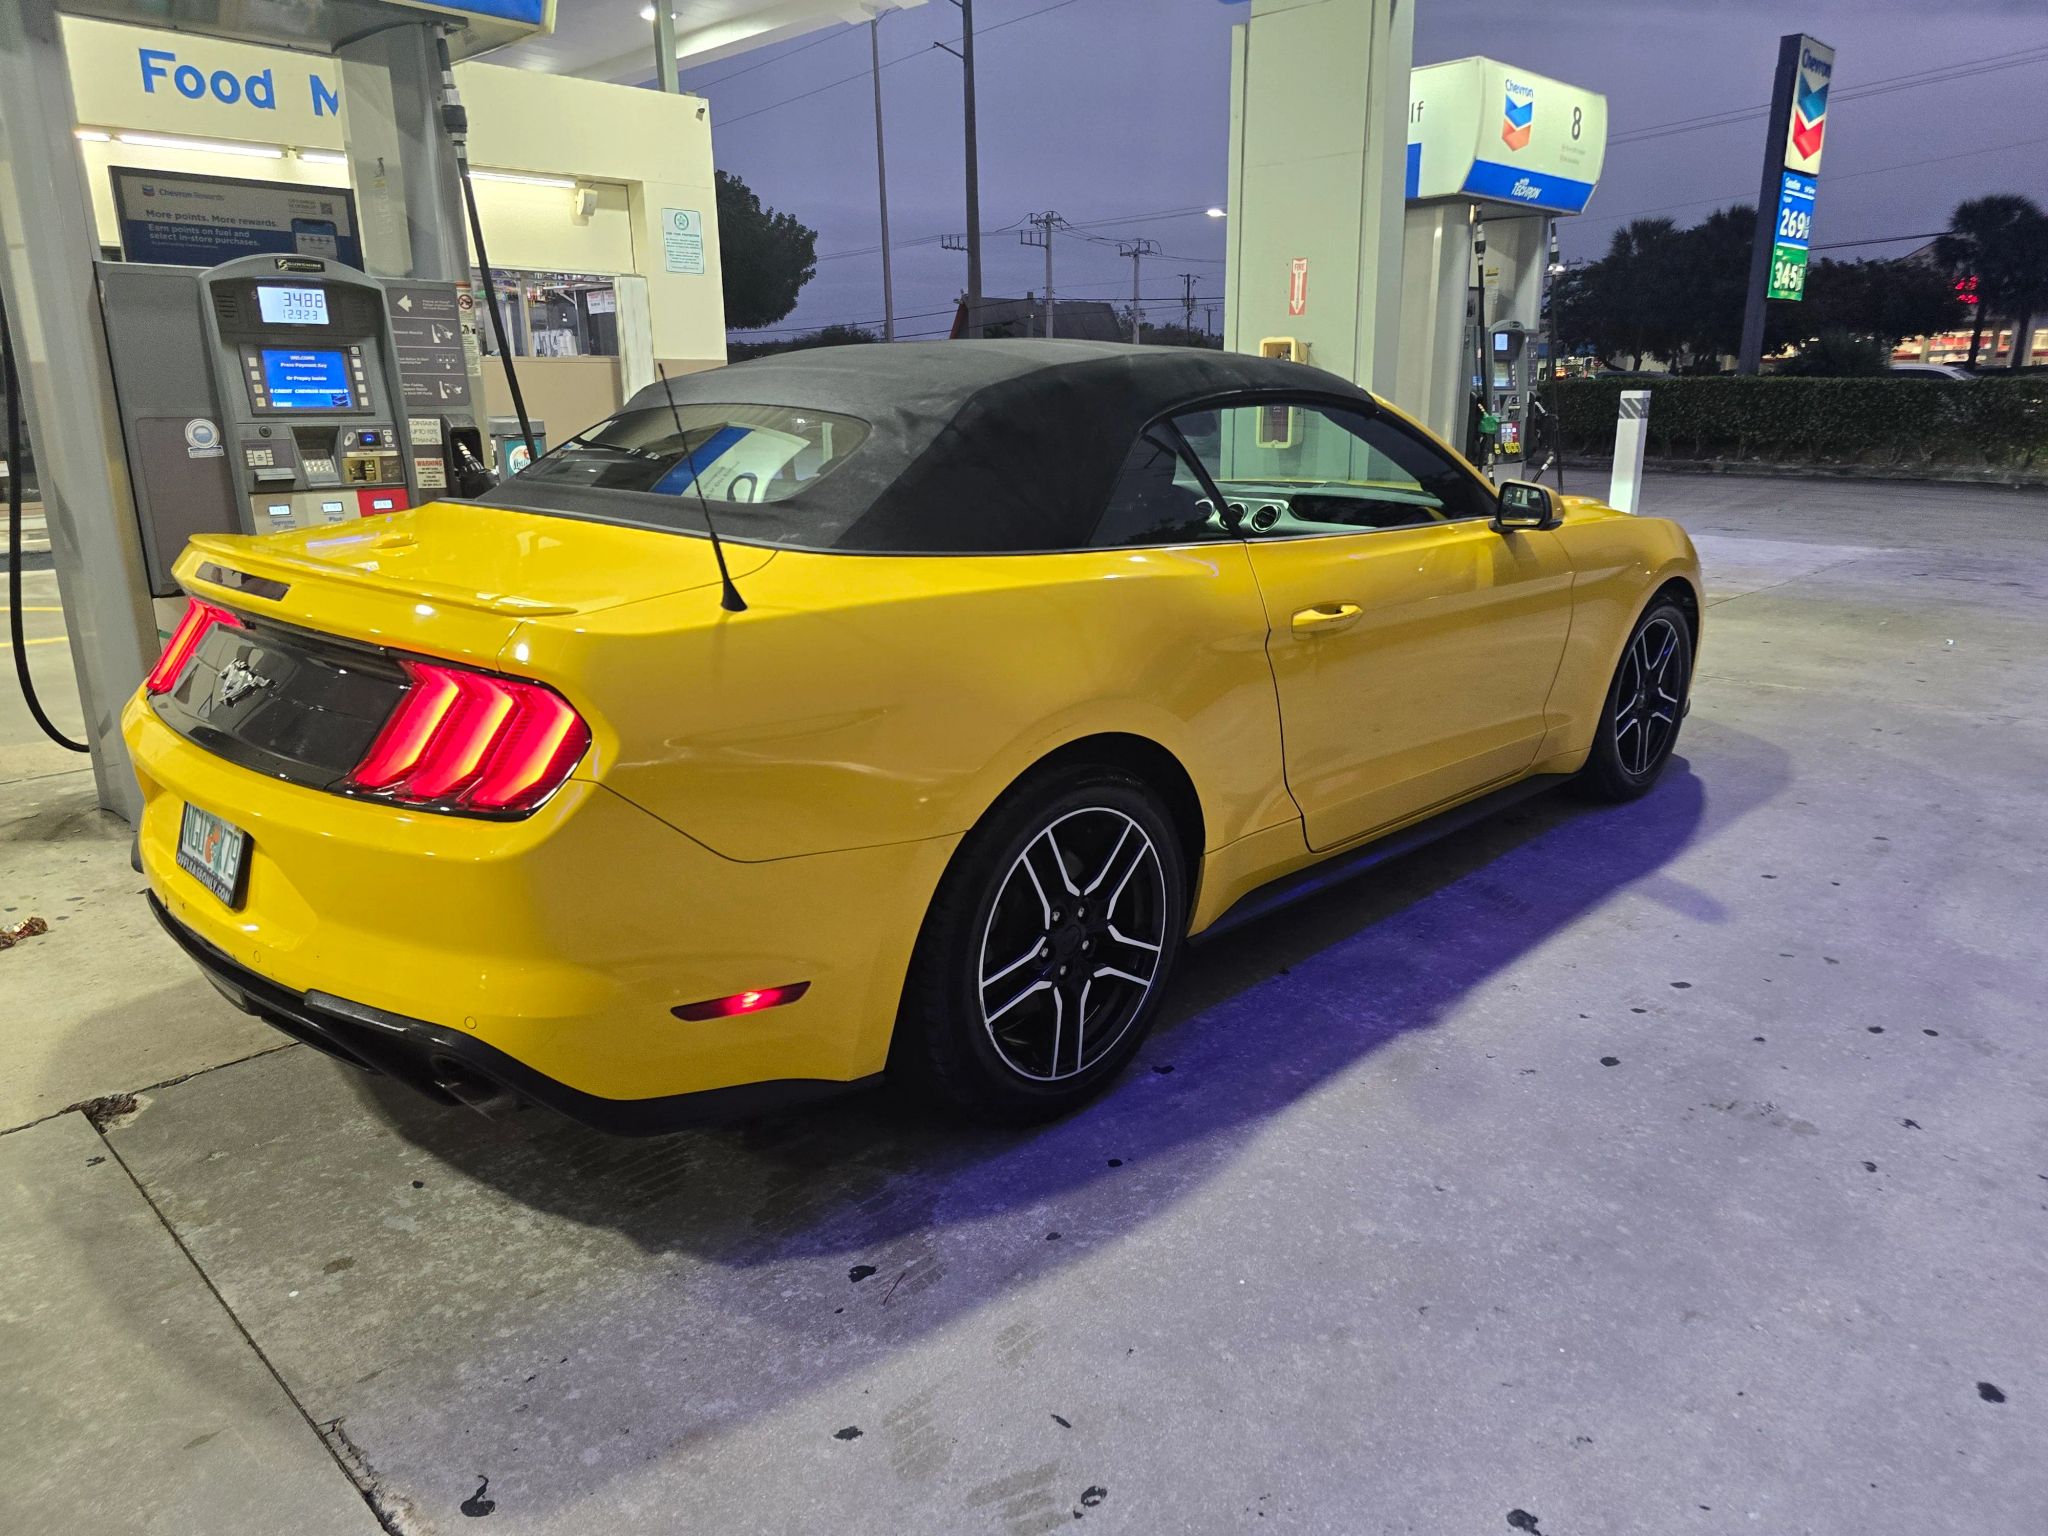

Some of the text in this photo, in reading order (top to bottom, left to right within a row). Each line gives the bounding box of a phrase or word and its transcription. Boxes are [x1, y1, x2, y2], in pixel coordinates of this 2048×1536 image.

[1802, 48, 1832, 78] Chevron
[138, 47, 339, 117] Food M
[1505, 79, 1534, 98] Chevron
[1410, 101, 1424, 123] lf
[1571, 106, 1582, 141] 8
[159, 188, 193, 198] Chevron
[146, 209, 279, 228] More points. More rewards.
[148, 223, 169, 232] Earn
[171, 225, 200, 235] points
[215, 228, 232, 237] fuel
[234, 229, 250, 238] and
[150, 231, 177, 241] select
[179, 234, 213, 243] in-store
[215, 237, 260, 247] purchases.
